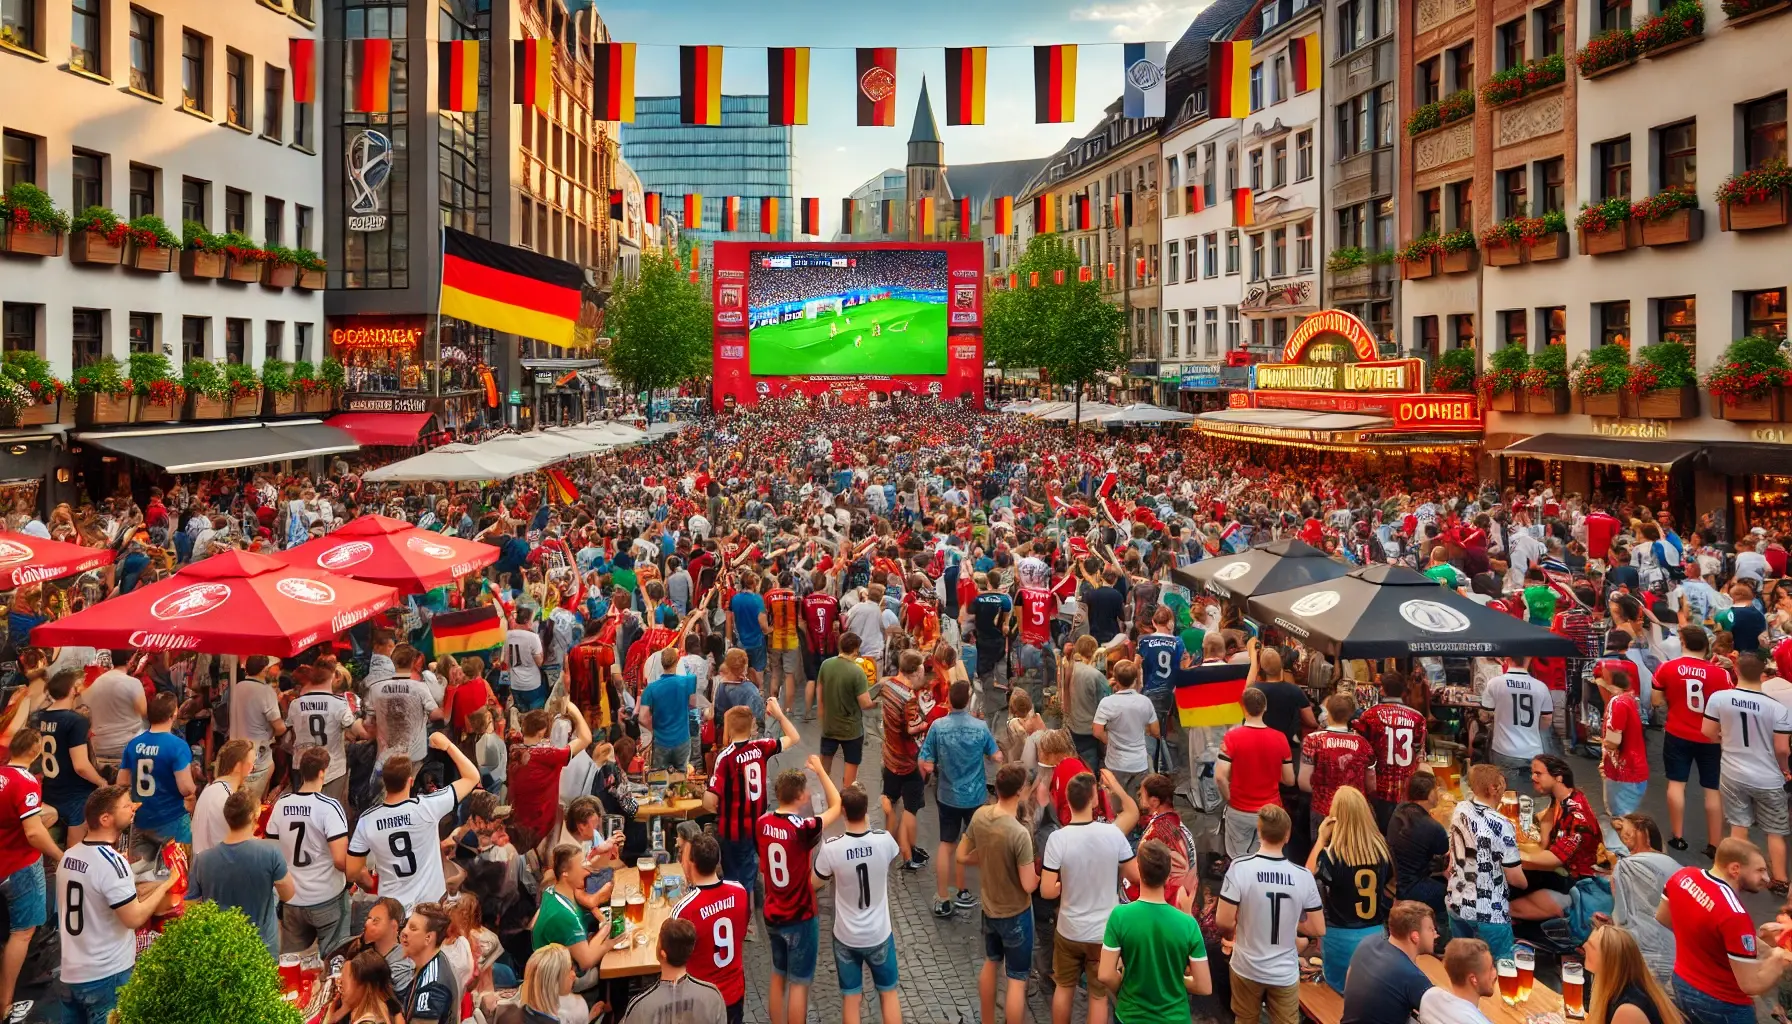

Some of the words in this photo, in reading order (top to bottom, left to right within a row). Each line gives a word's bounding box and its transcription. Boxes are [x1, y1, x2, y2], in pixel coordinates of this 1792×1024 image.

[1031, 601, 1045, 625] 5
[1155, 651, 1172, 679] 9
[1511, 693, 1535, 728] 19
[41, 735, 60, 779] 8
[1385, 726, 1414, 767] 13
[388, 831, 417, 878] 9
[767, 842, 790, 888] 8
[66, 880, 84, 936] 8
[712, 917, 735, 969] 9
